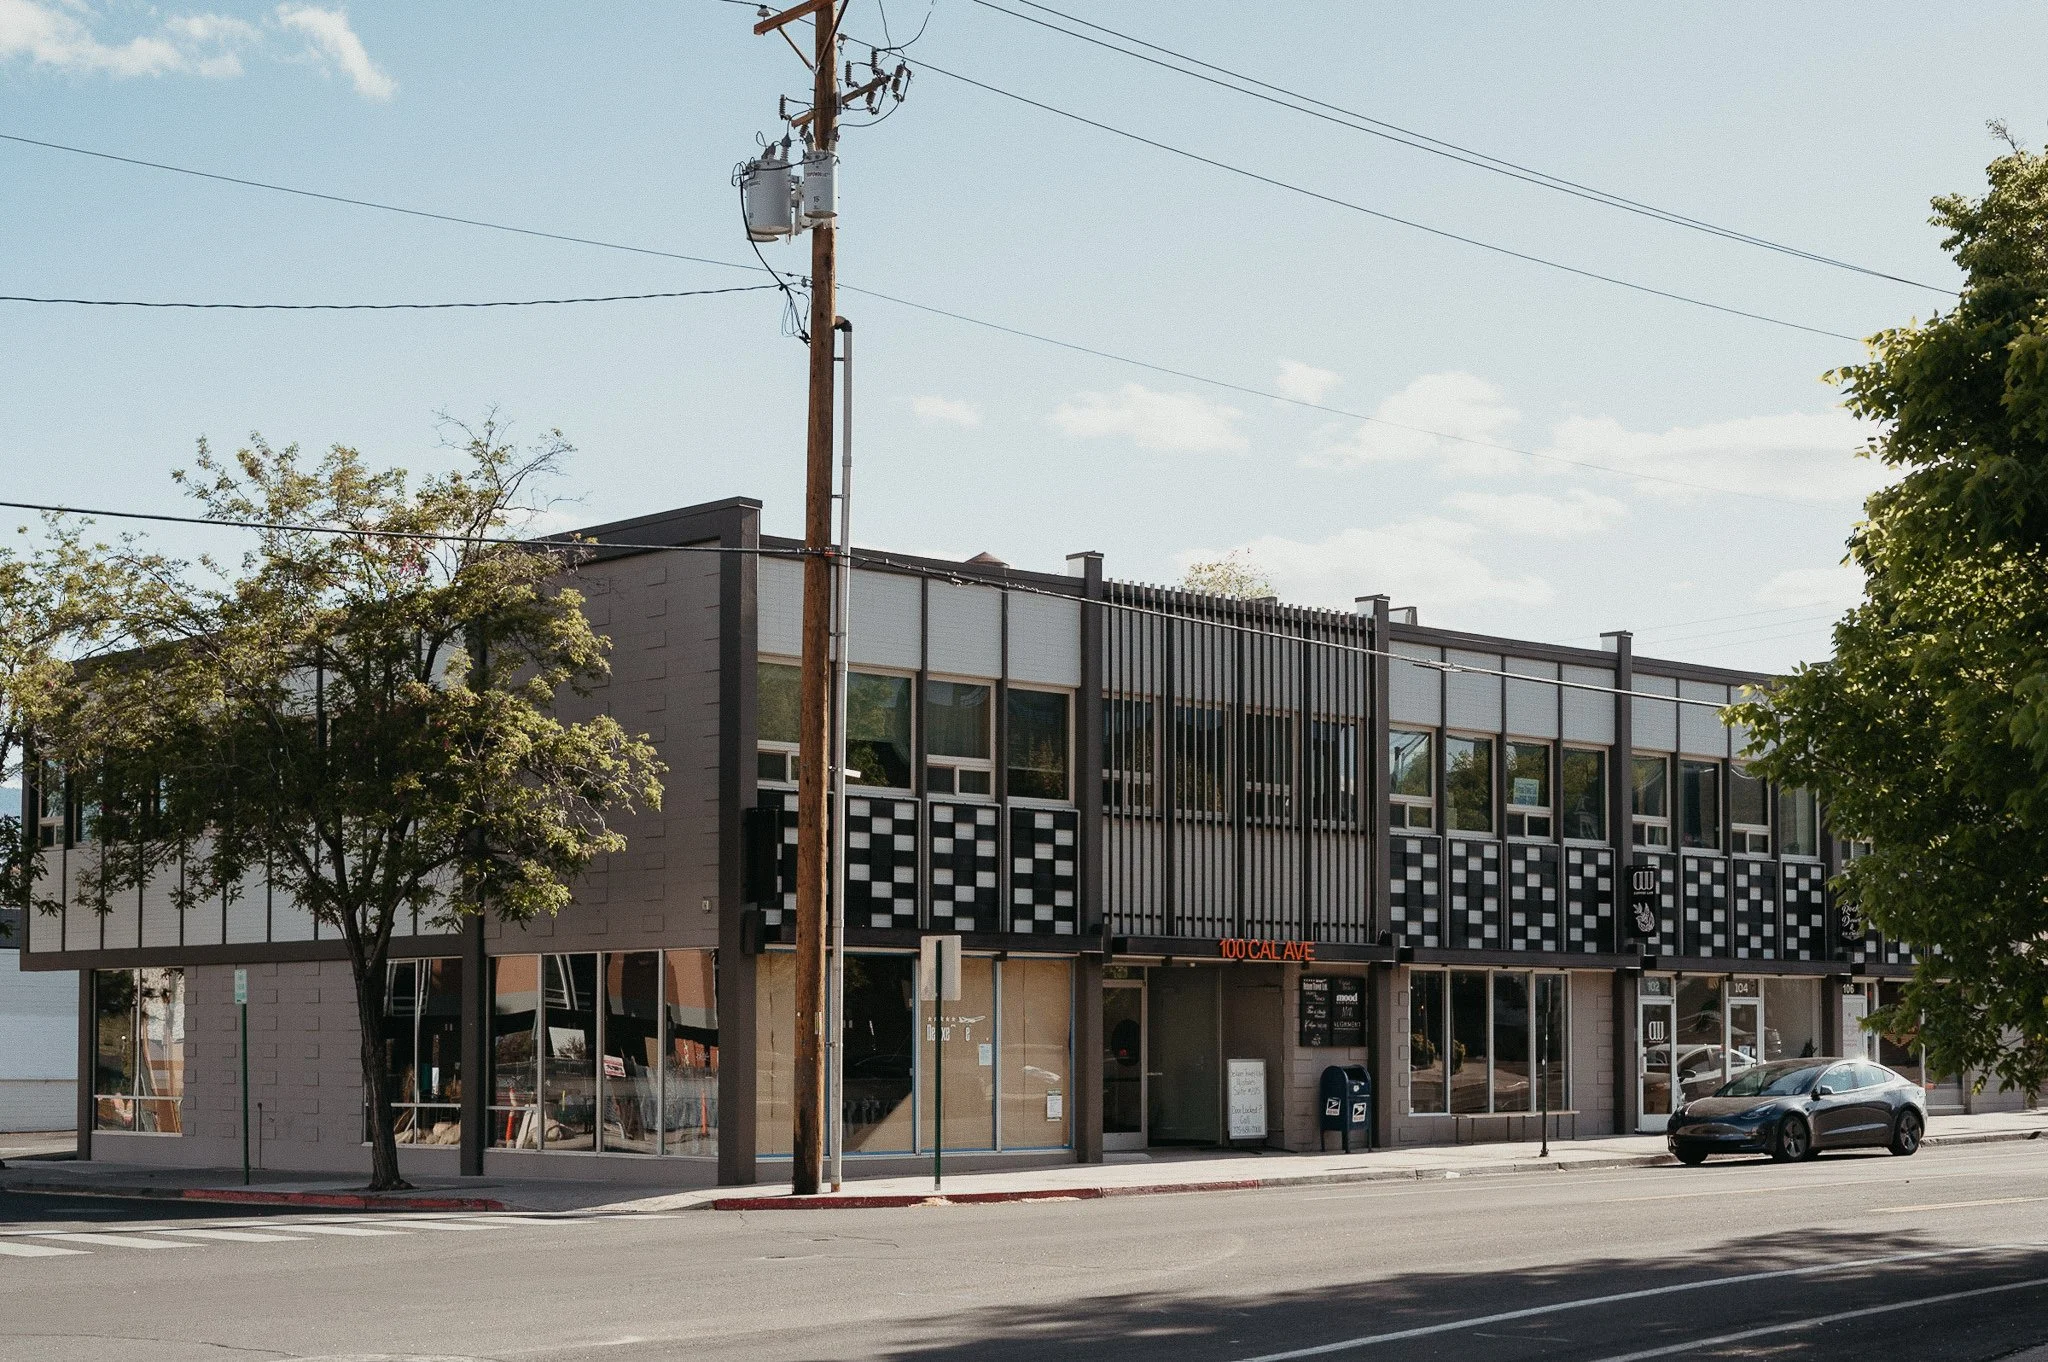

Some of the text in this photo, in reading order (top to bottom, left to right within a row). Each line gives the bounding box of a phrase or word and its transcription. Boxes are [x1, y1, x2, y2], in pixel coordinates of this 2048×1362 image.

[1220, 938, 1315, 960] 100 CAL AVE
[1647, 981, 1660, 992] 102
[1735, 983, 1748, 993] 104
[1843, 984, 1854, 994] 106
